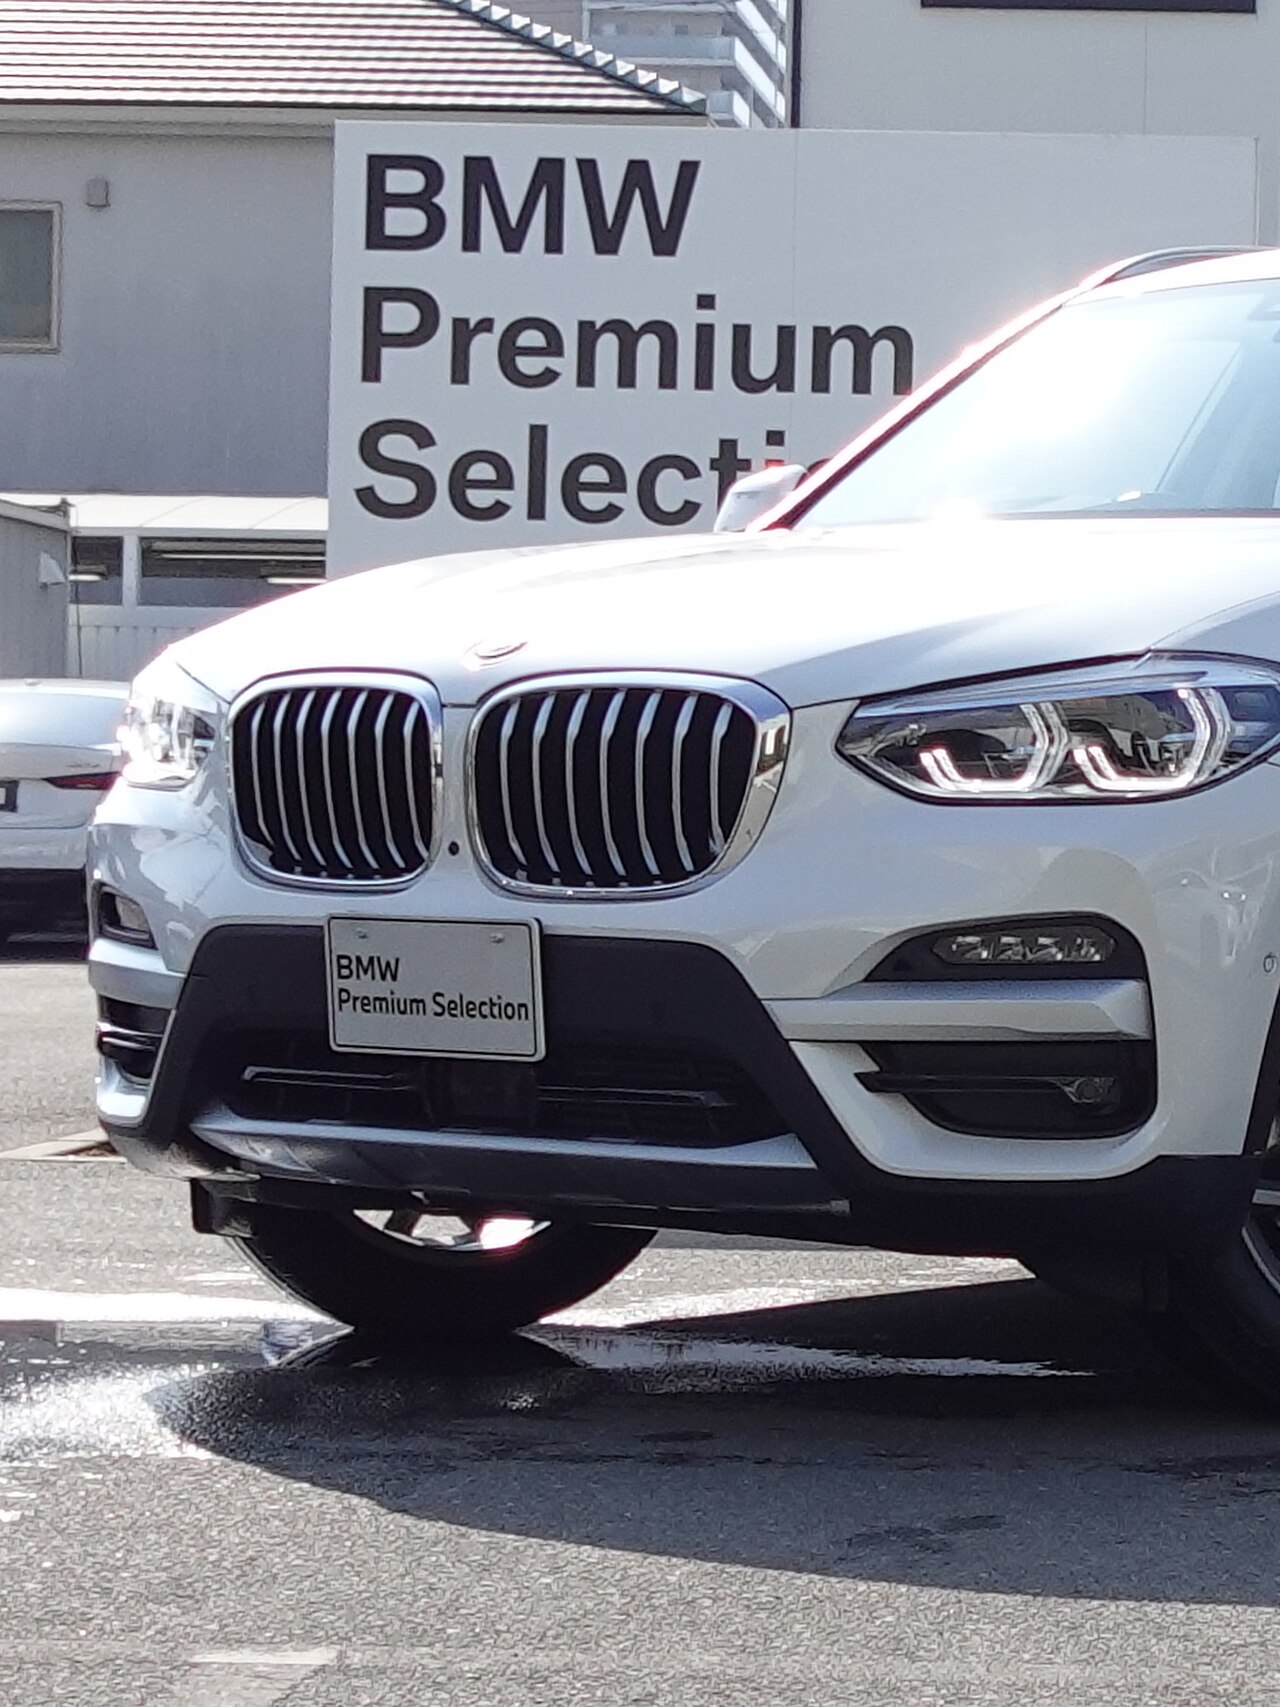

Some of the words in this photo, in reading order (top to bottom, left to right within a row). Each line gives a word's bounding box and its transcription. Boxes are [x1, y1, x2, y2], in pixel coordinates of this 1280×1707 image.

[364, 153, 701, 257] BMW
[360, 285, 914, 396] Premium
[354, 418, 832, 526] Select
[336, 954, 400, 982] BMW
[337, 987, 427, 1016] Premium
[432, 991, 529, 1021] Selection
